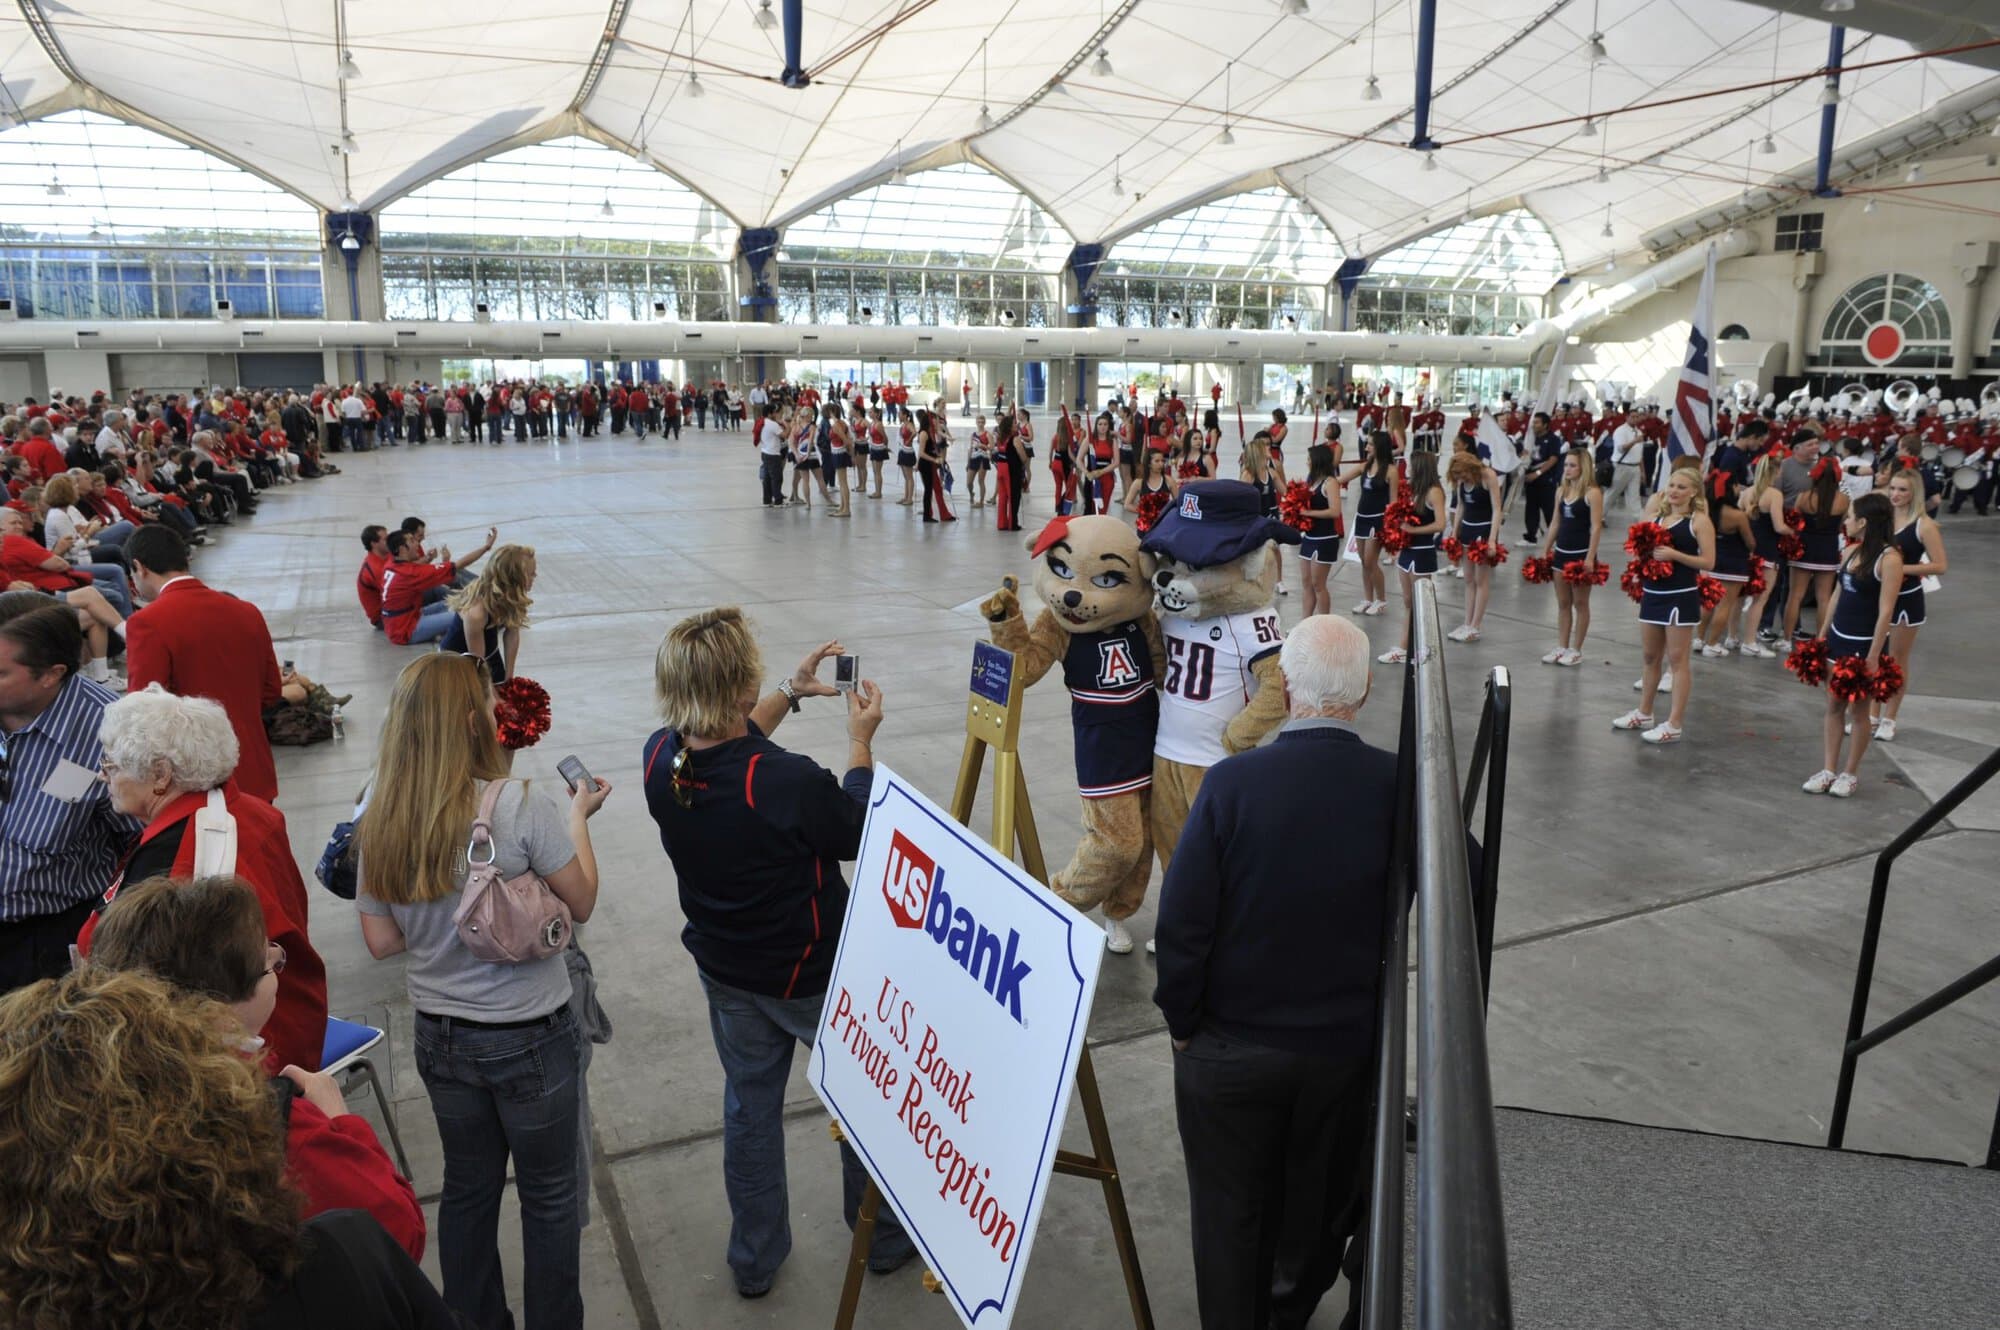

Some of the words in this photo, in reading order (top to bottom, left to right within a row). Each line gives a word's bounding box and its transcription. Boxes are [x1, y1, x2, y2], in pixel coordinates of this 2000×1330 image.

[1180, 493, 1202, 520] A
[382, 569, 396, 602] 7
[1096, 638, 1141, 688] A
[1165, 635, 1215, 701] 50
[876, 975, 915, 1053] U.S.
[914, 1023, 976, 1124] Bank
[829, 986, 899, 1100] Private
[896, 1071, 1017, 1263] Reception
